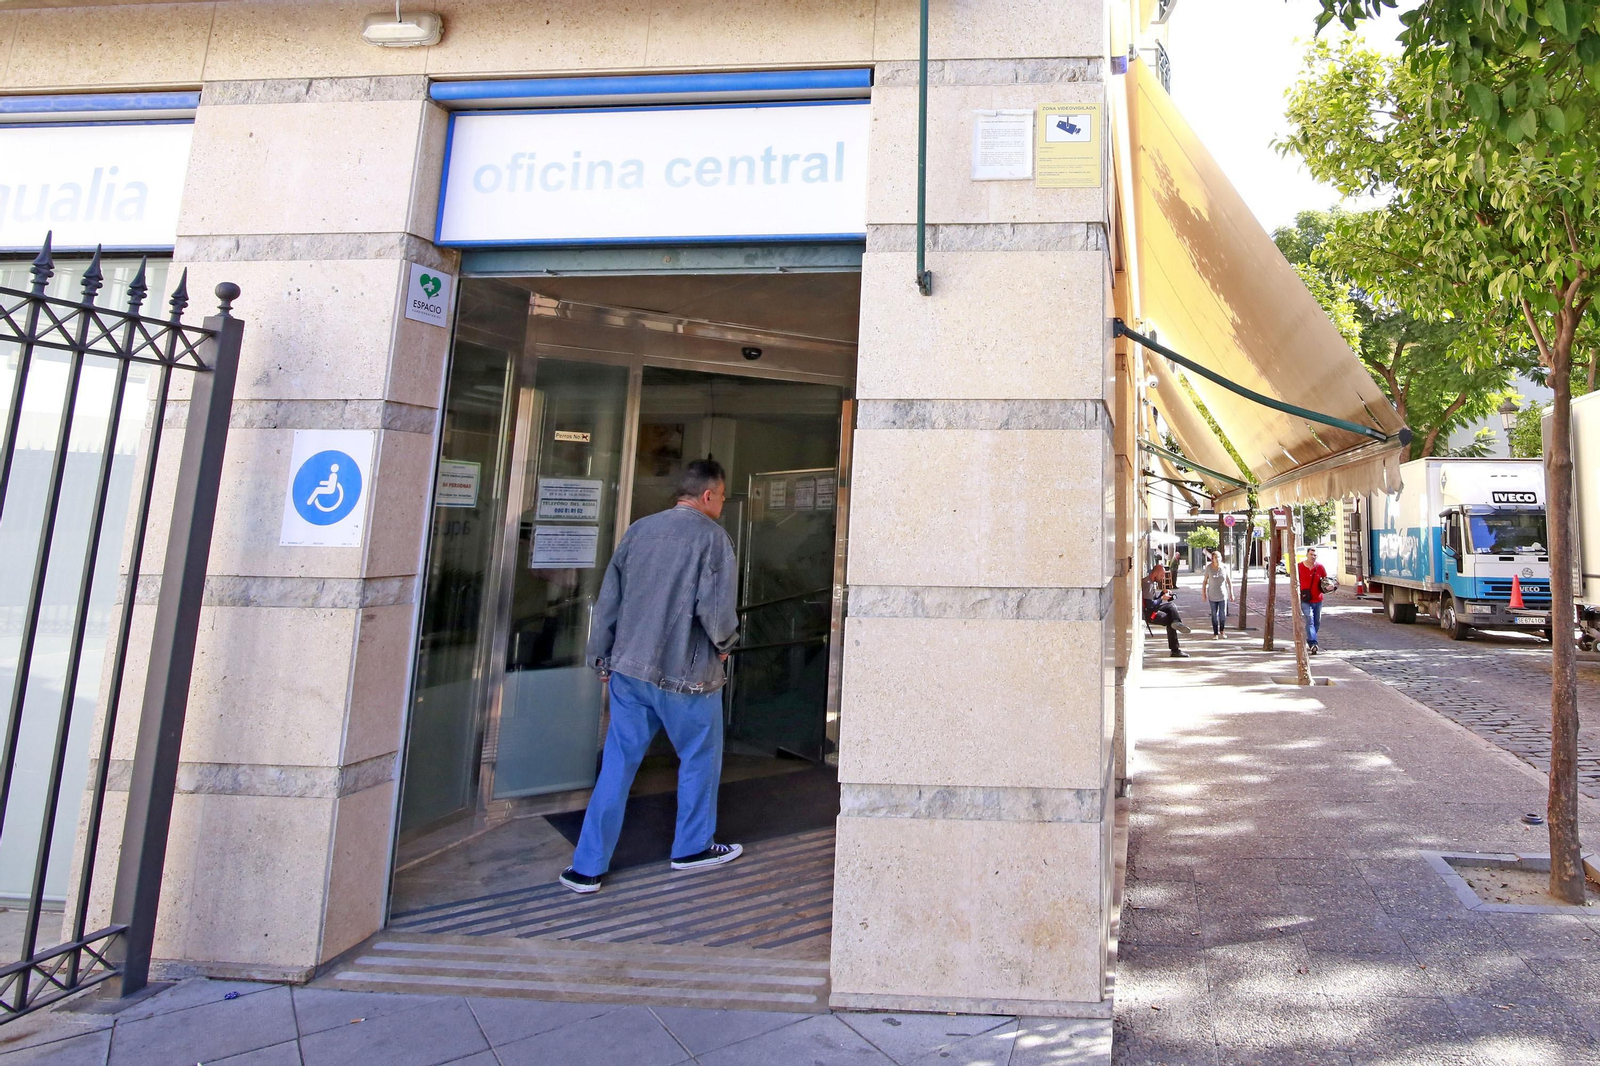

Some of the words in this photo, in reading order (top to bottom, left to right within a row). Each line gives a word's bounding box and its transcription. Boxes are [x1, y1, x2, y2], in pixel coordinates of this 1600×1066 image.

[471, 151, 645, 194] oficina
[664, 141, 846, 189] central
[413, 299, 442, 315] ESPACIO
[556, 432, 572, 440] Perros
[1493, 492, 1535, 503] IVECO
